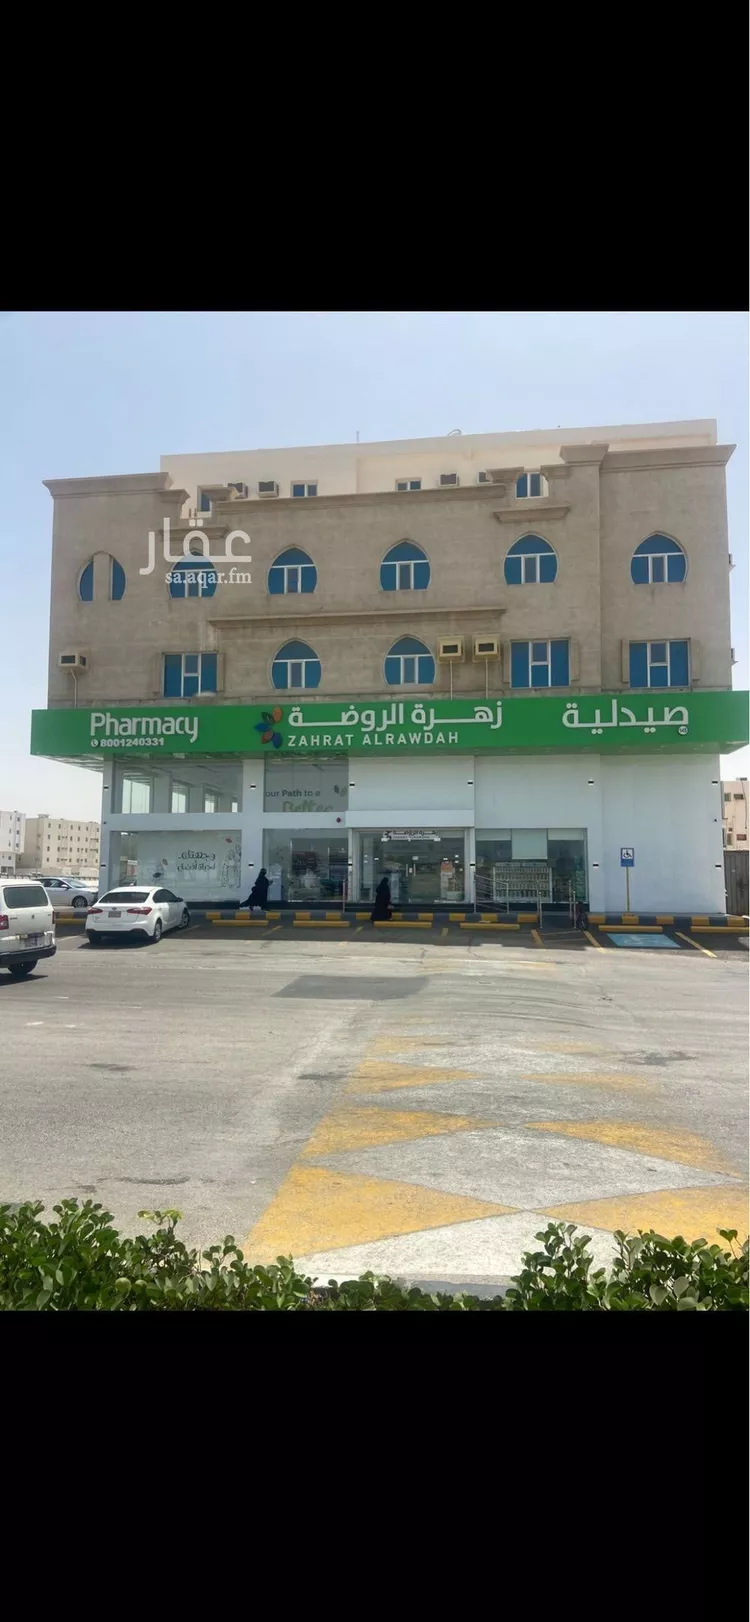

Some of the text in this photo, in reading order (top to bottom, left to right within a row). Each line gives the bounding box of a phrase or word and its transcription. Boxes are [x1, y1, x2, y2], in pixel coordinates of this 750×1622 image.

[90, 712, 199, 743] Pharmacy
[288, 701, 502, 732] زهرة الروضة
[562, 699, 689, 735] صيدلية
[100, 738, 164, 747] 8001240331
[287, 732, 458, 747] ZAHRAT ALRAWDAH
[282, 789, 302, 797] Path
